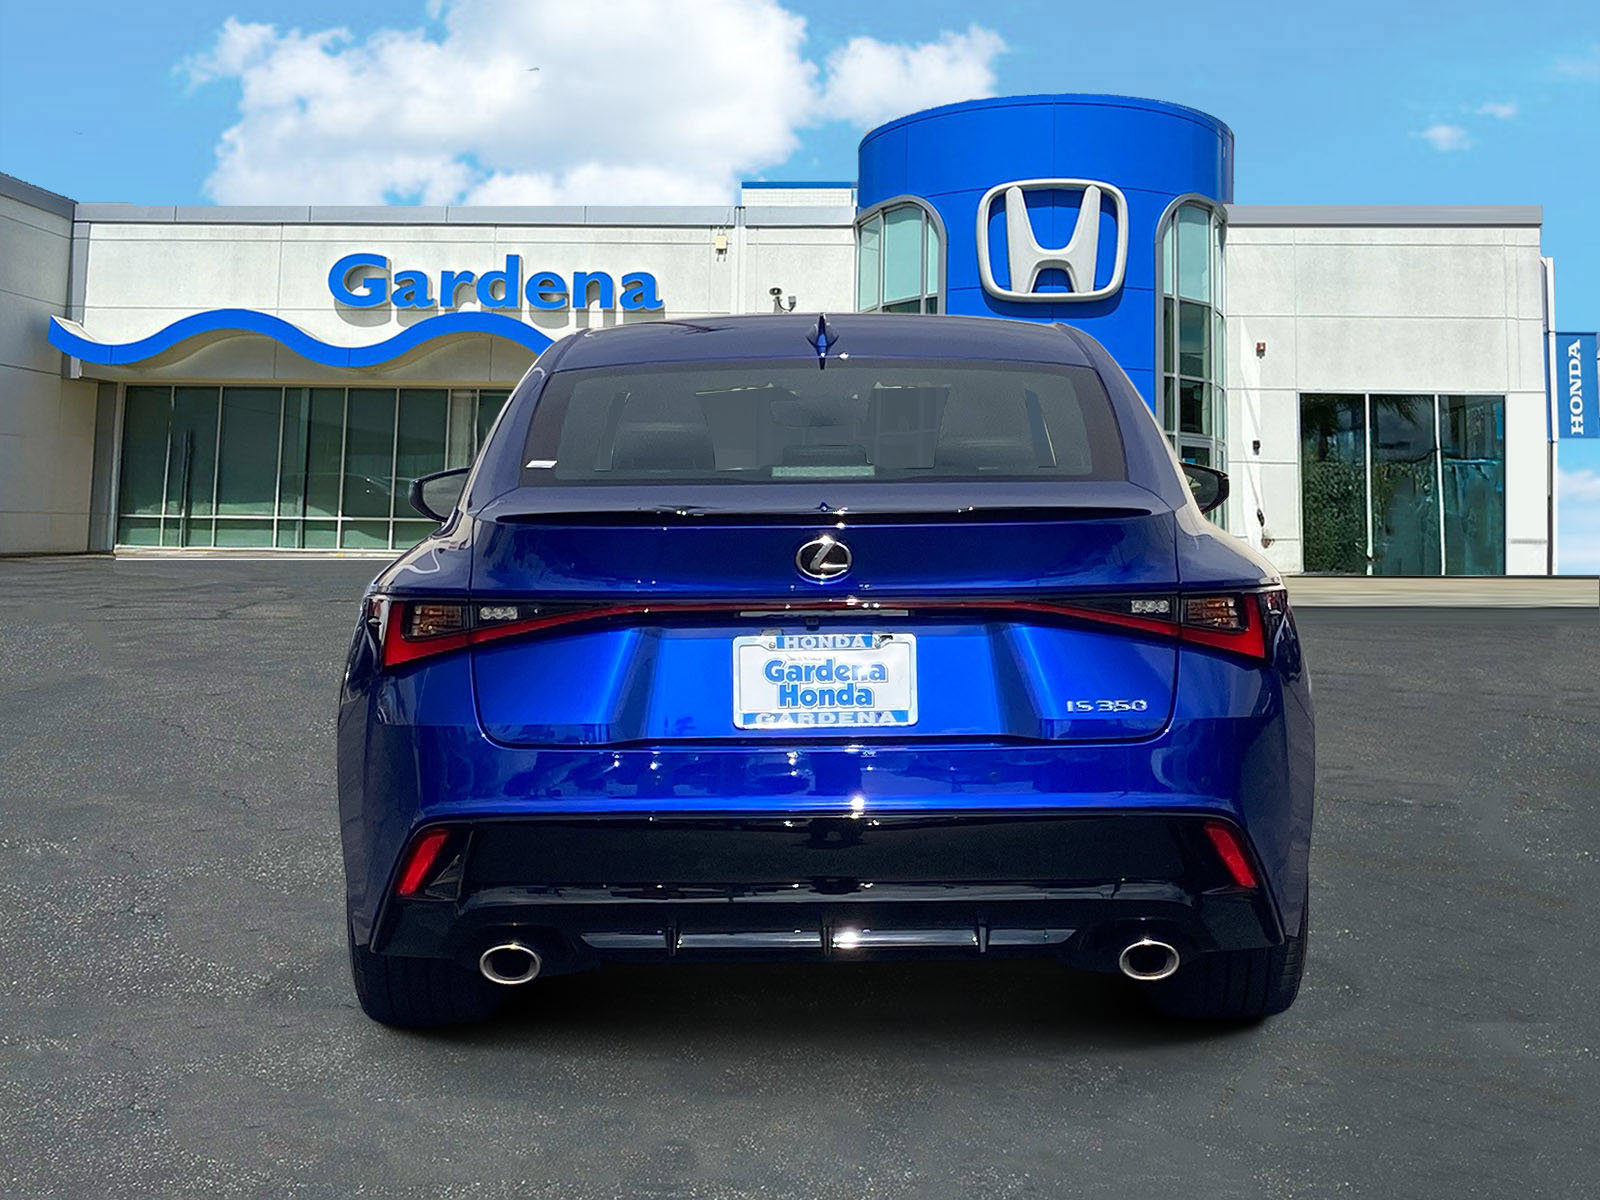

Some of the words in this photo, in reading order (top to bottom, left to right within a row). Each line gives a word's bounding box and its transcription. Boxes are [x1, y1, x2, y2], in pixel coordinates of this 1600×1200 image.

[328, 252, 664, 310] Gardena
[1567, 339, 1584, 435] HONDA
[783, 634, 868, 649] HONDA
[778, 683, 874, 707] Honda
[1066, 700, 1094, 712] IS
[1095, 699, 1148, 712] 350
[754, 711, 898, 725] GARDENA
